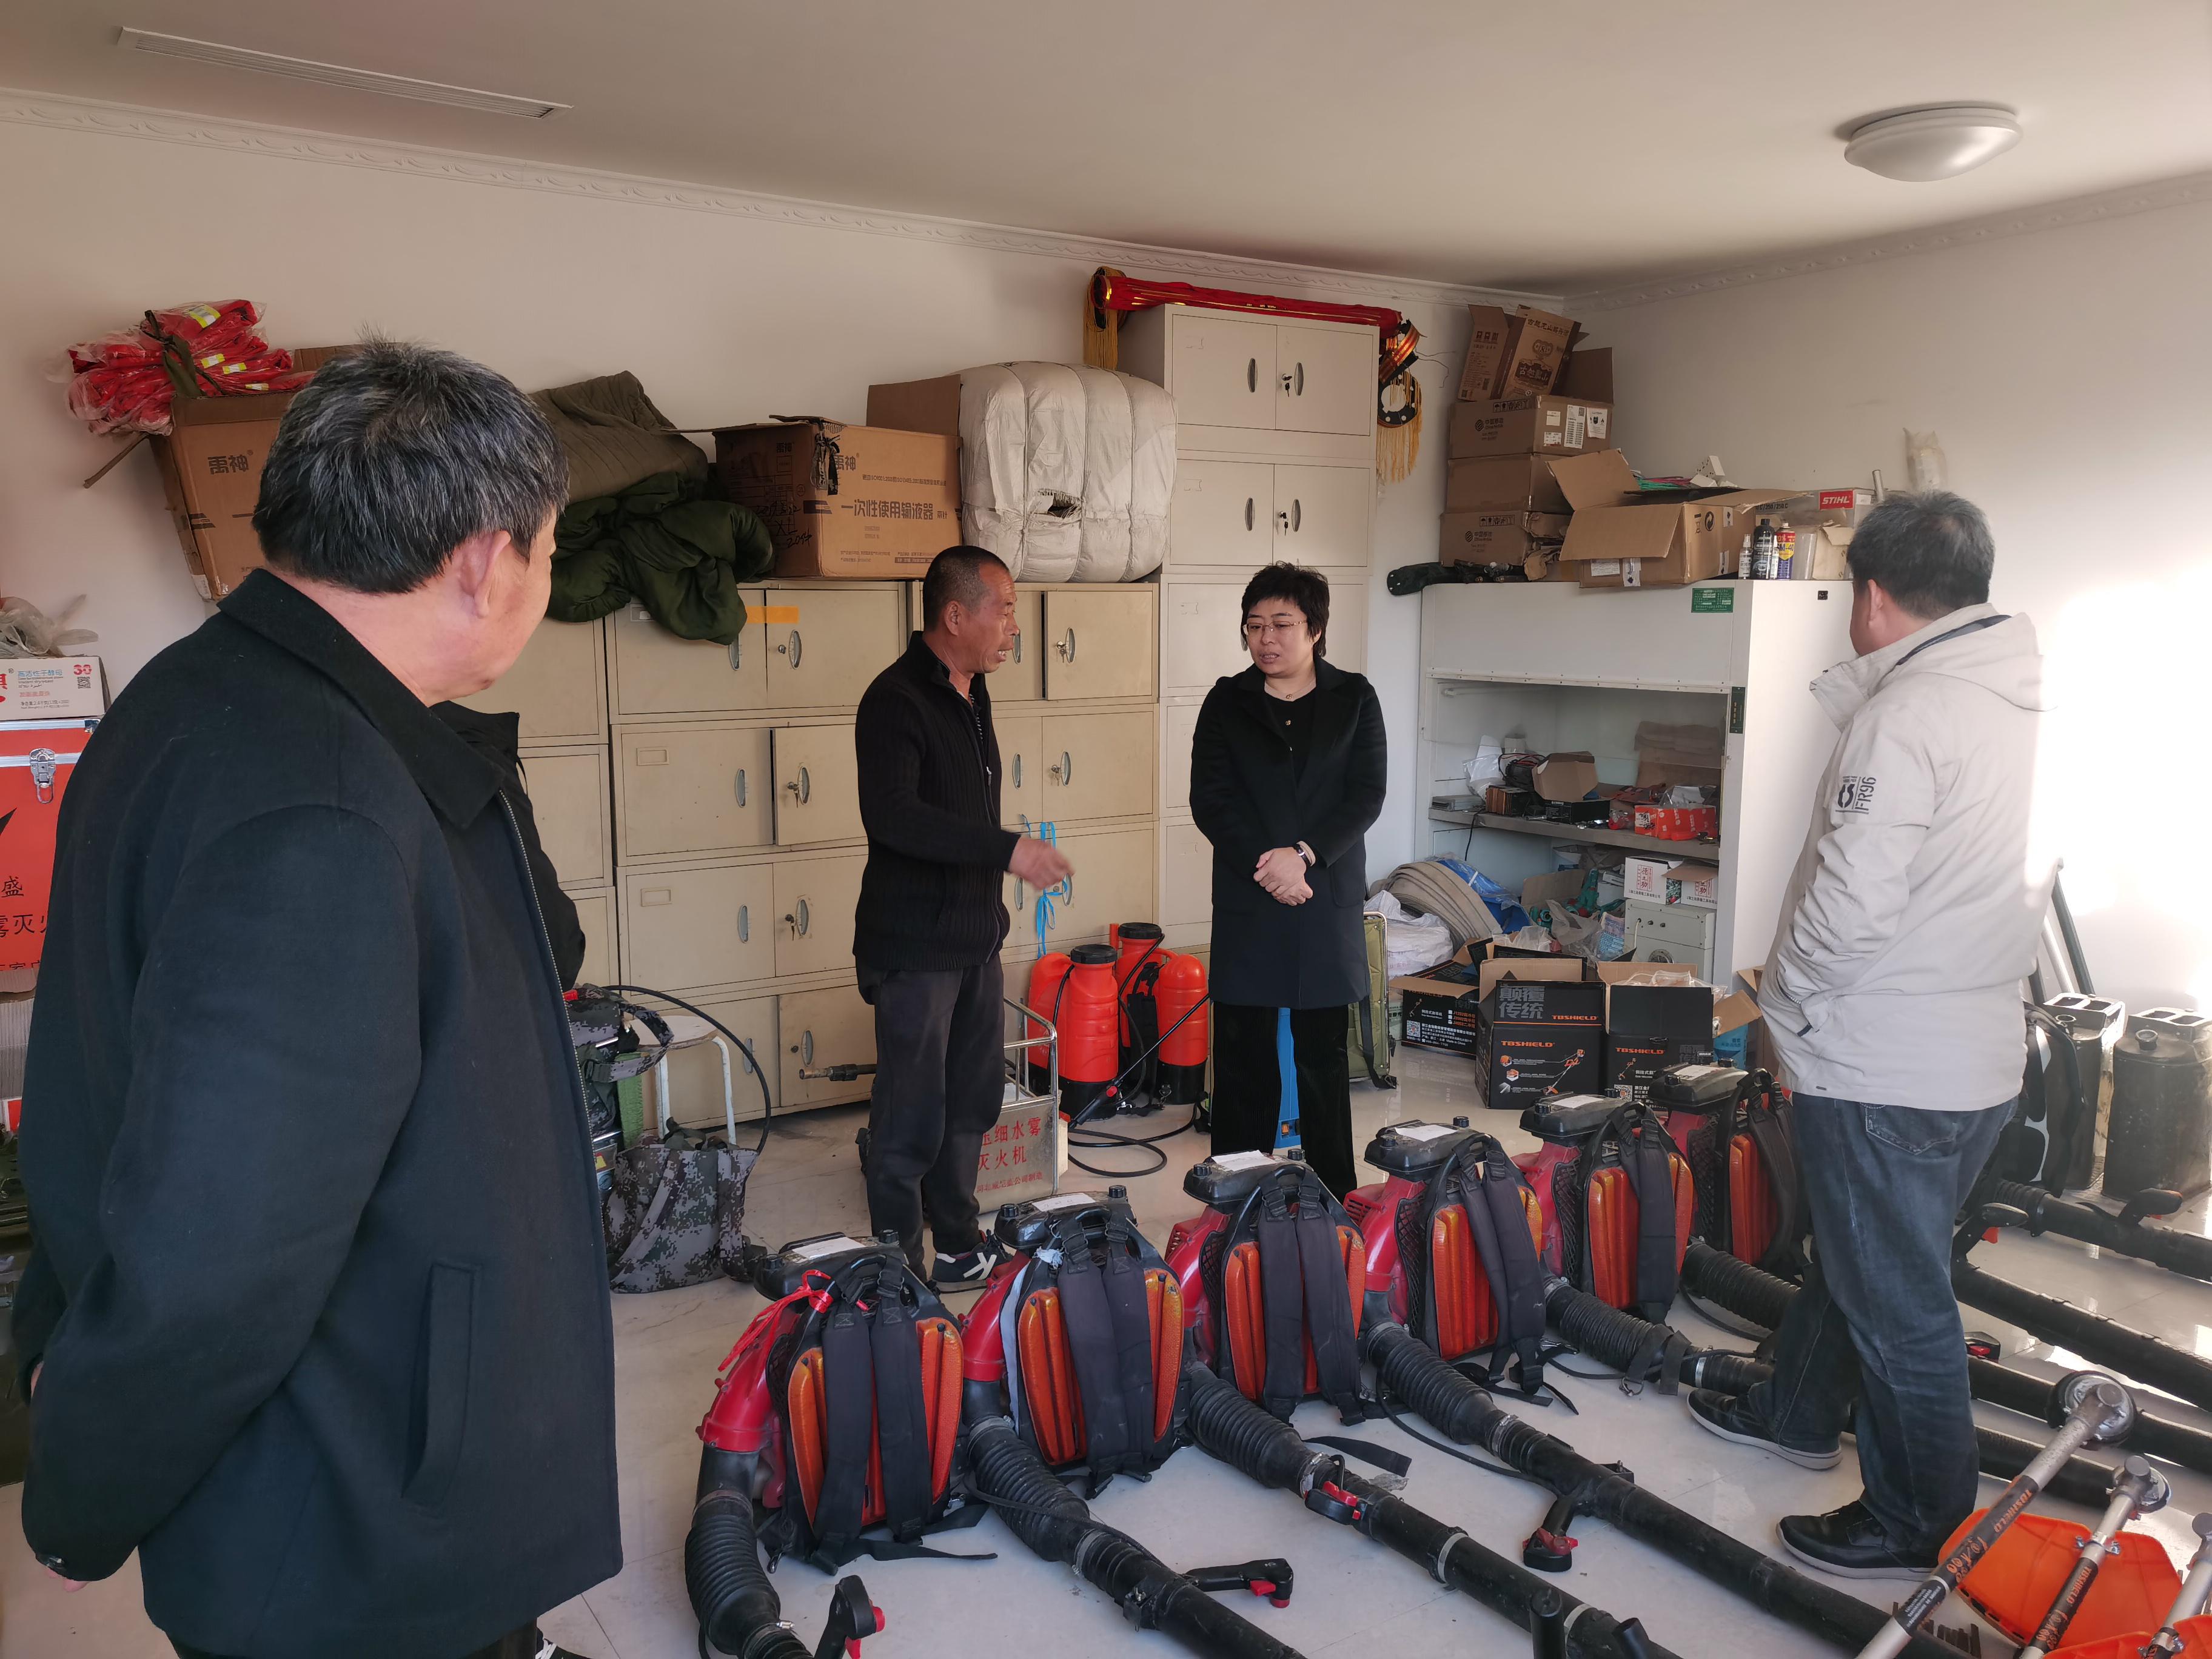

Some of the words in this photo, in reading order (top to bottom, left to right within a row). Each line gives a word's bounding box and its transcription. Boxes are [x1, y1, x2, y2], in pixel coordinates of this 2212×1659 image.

[841, 498, 933, 520] 一次性使用输液器
[1822, 495, 1850, 504] STIHL
[1, 876, 24, 898] 盛
[1499, 982, 1546, 1002] 颠覆
[1499, 1002, 1544, 1019] 传统
[978, 1145, 1027, 1171] 灭火机
